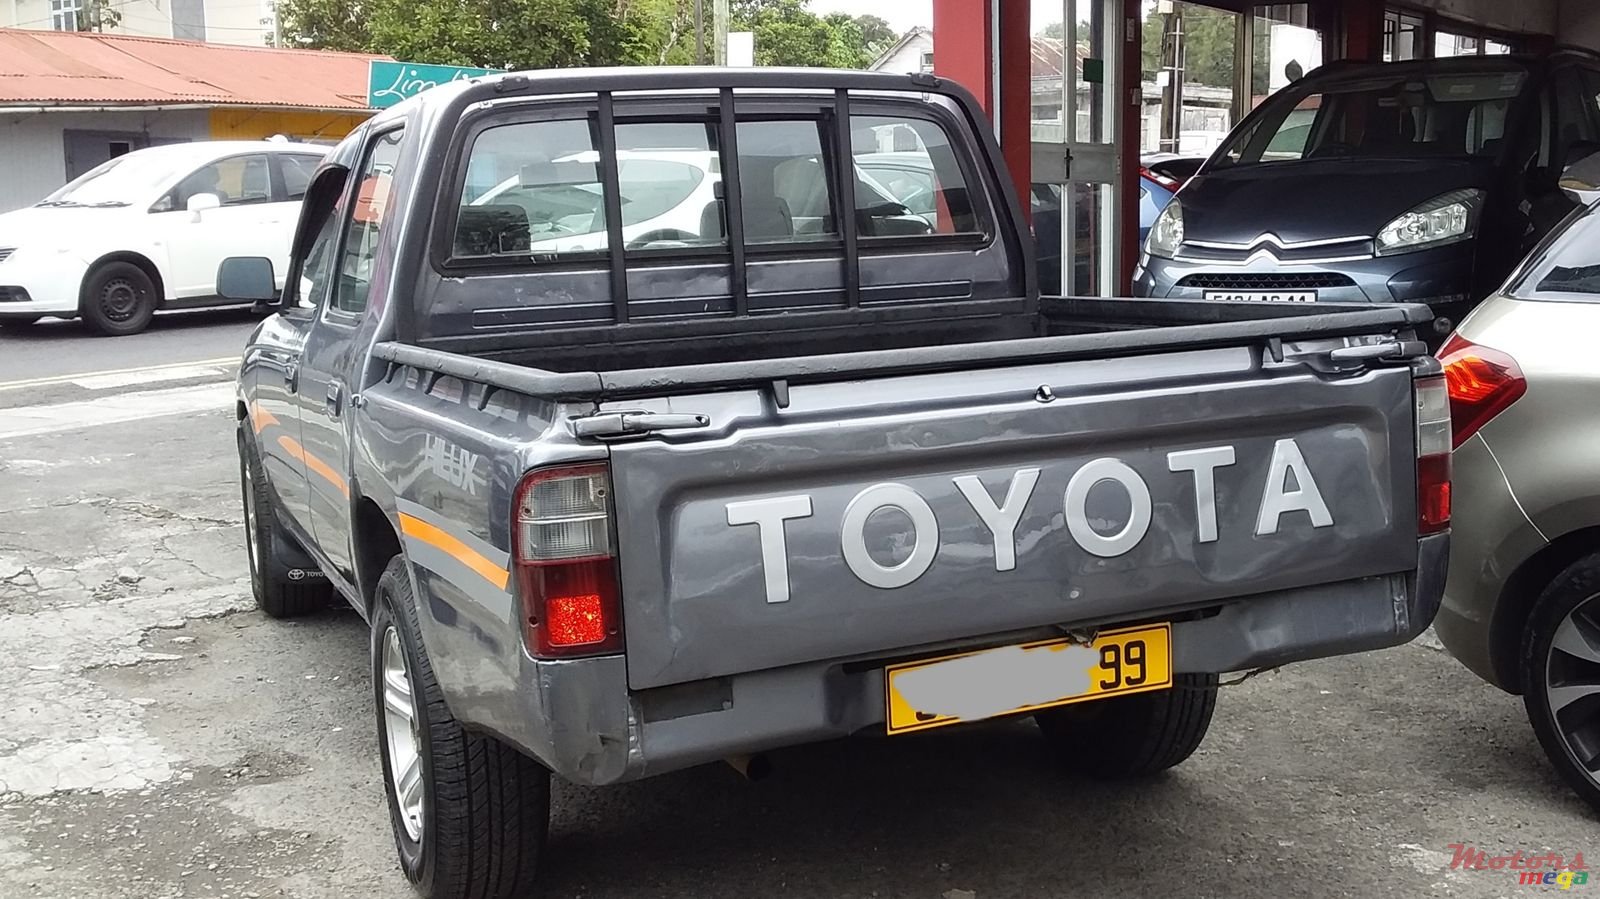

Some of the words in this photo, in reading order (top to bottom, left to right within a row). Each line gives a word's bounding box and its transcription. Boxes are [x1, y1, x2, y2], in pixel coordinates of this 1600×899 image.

[424, 432, 479, 496] HILUX
[726, 438, 1334, 604] TOYOTA
[1099, 640, 1146, 690] 99
